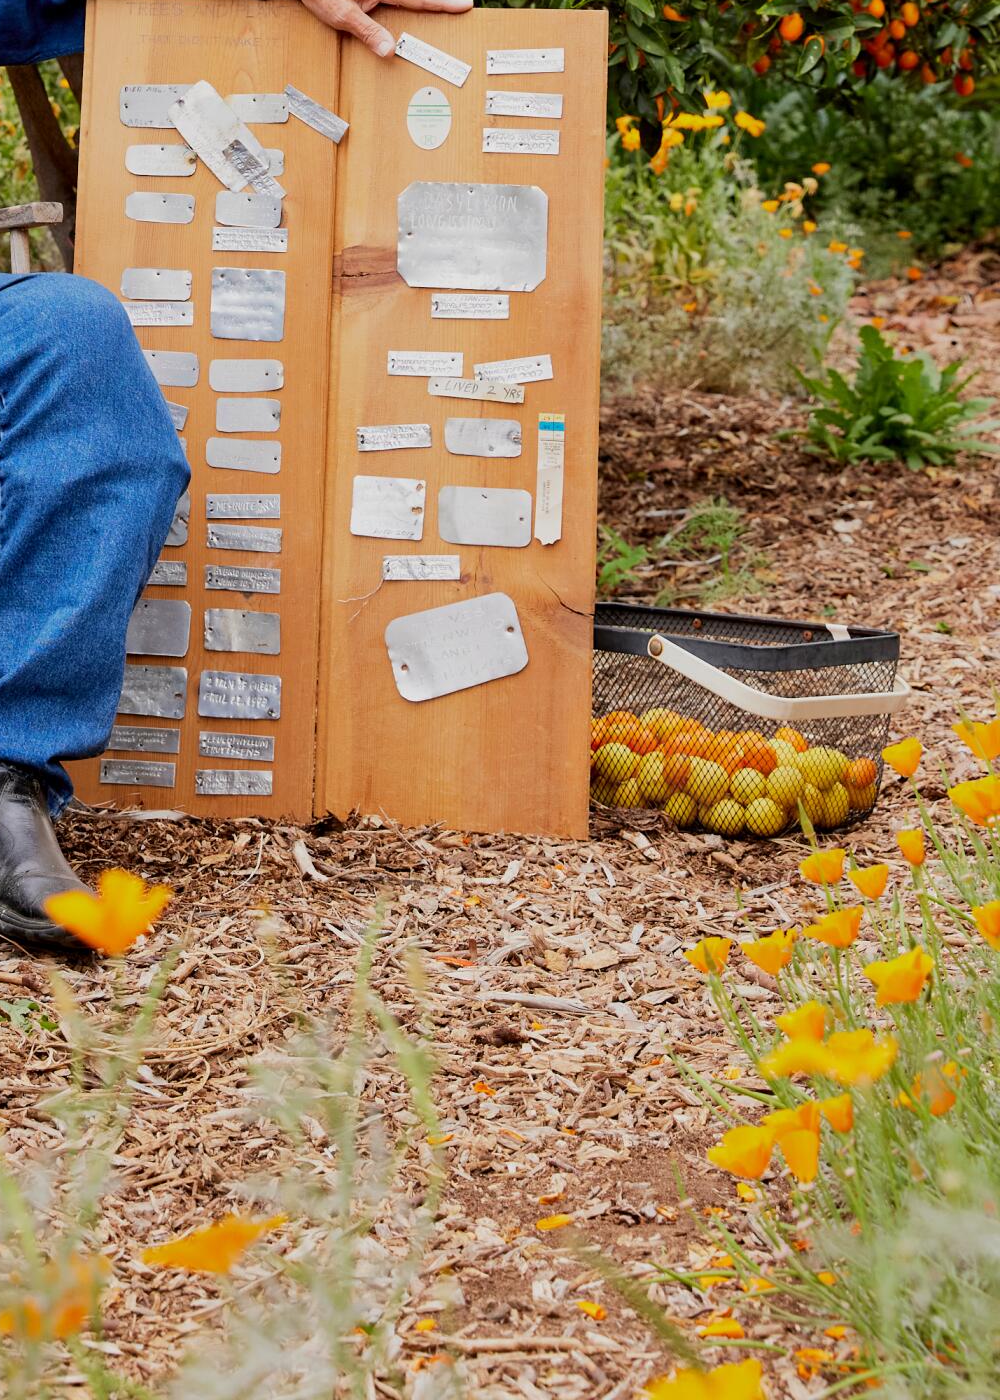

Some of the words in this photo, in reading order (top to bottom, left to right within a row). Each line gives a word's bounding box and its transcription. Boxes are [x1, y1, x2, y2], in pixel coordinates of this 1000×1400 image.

[126, 1, 184, 17] TREES
[193, 1, 228, 18] AND
[140, 33, 170, 46] THAT
[444, 379, 479, 394] LIVED
[487, 384, 497, 395] 2
[503, 386, 522, 400] YRS
[206, 735, 269, 749] LEUCOPHYLLUM
